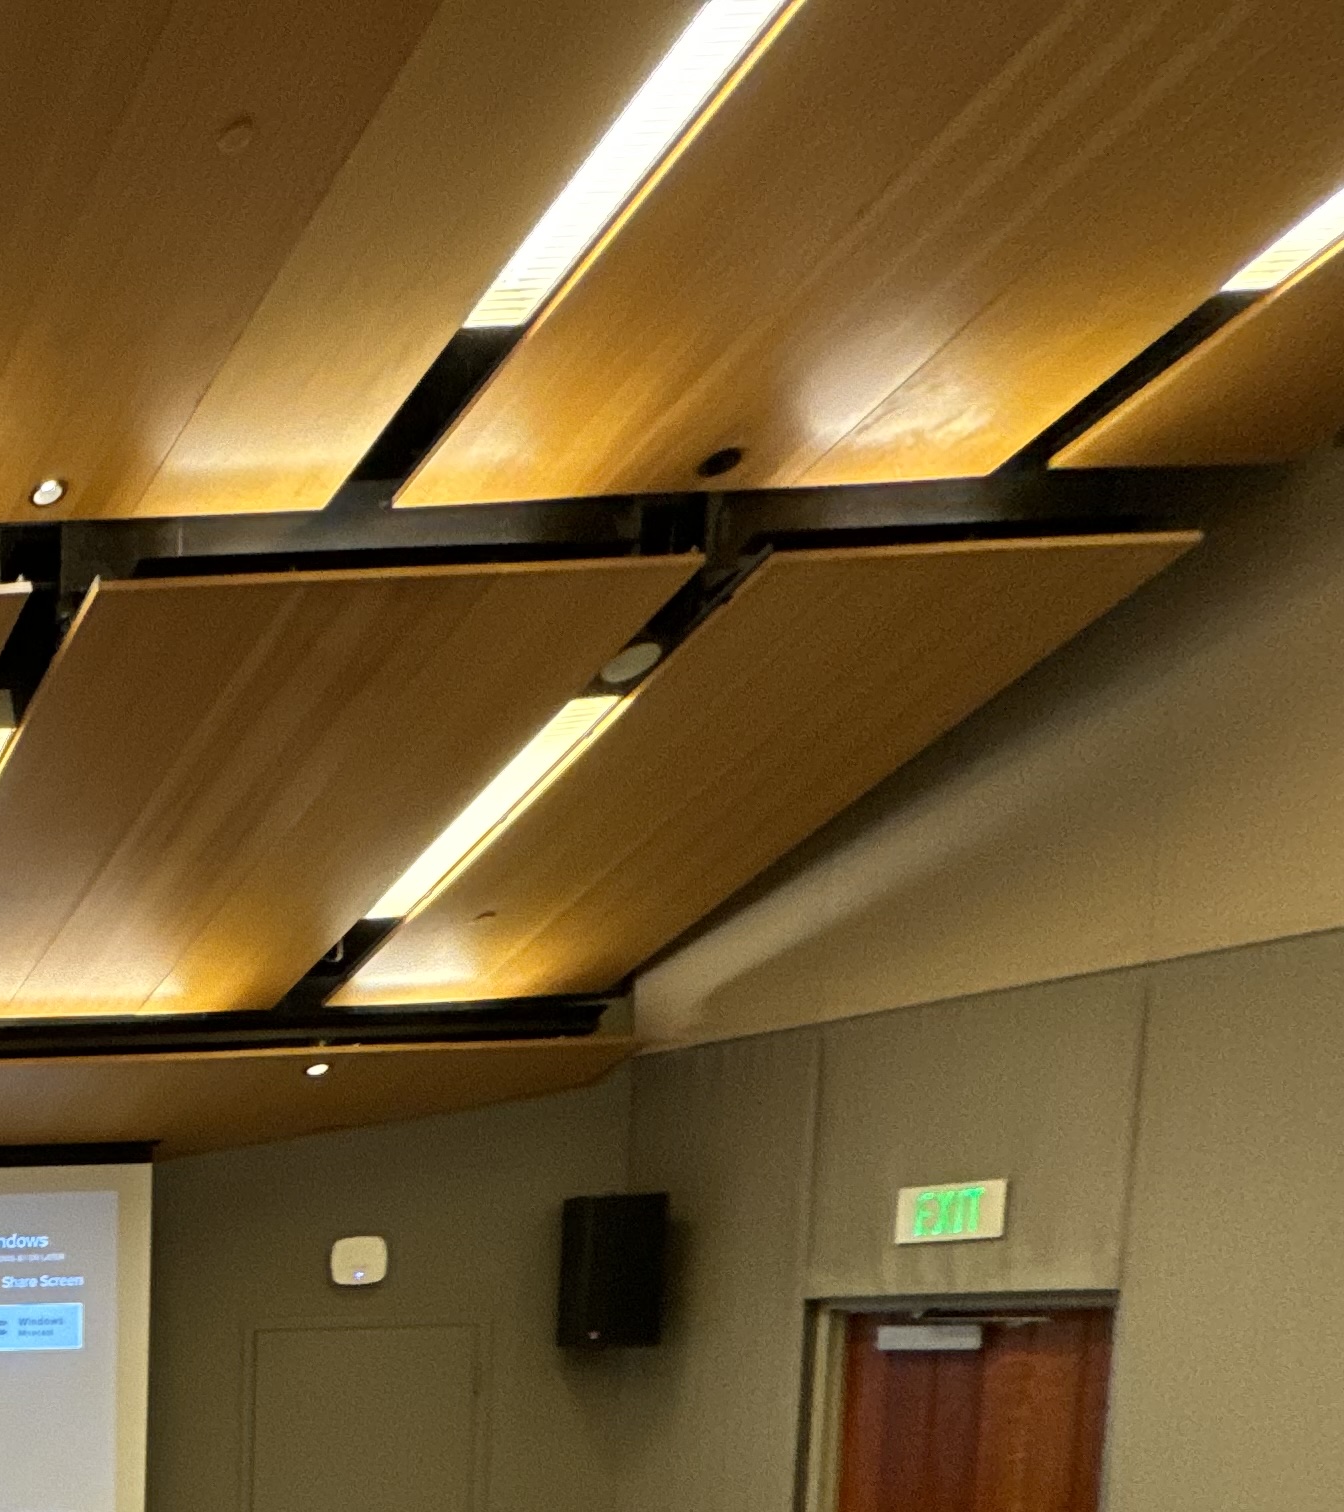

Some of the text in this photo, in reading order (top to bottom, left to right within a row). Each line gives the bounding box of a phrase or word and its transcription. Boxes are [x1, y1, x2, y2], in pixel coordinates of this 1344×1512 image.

[912, 1186, 985, 1237] EXIT
[1, 1276, 38, 1289] Share
[39, 1274, 85, 1287] Screen
[18, 1316, 64, 1326] Windows
